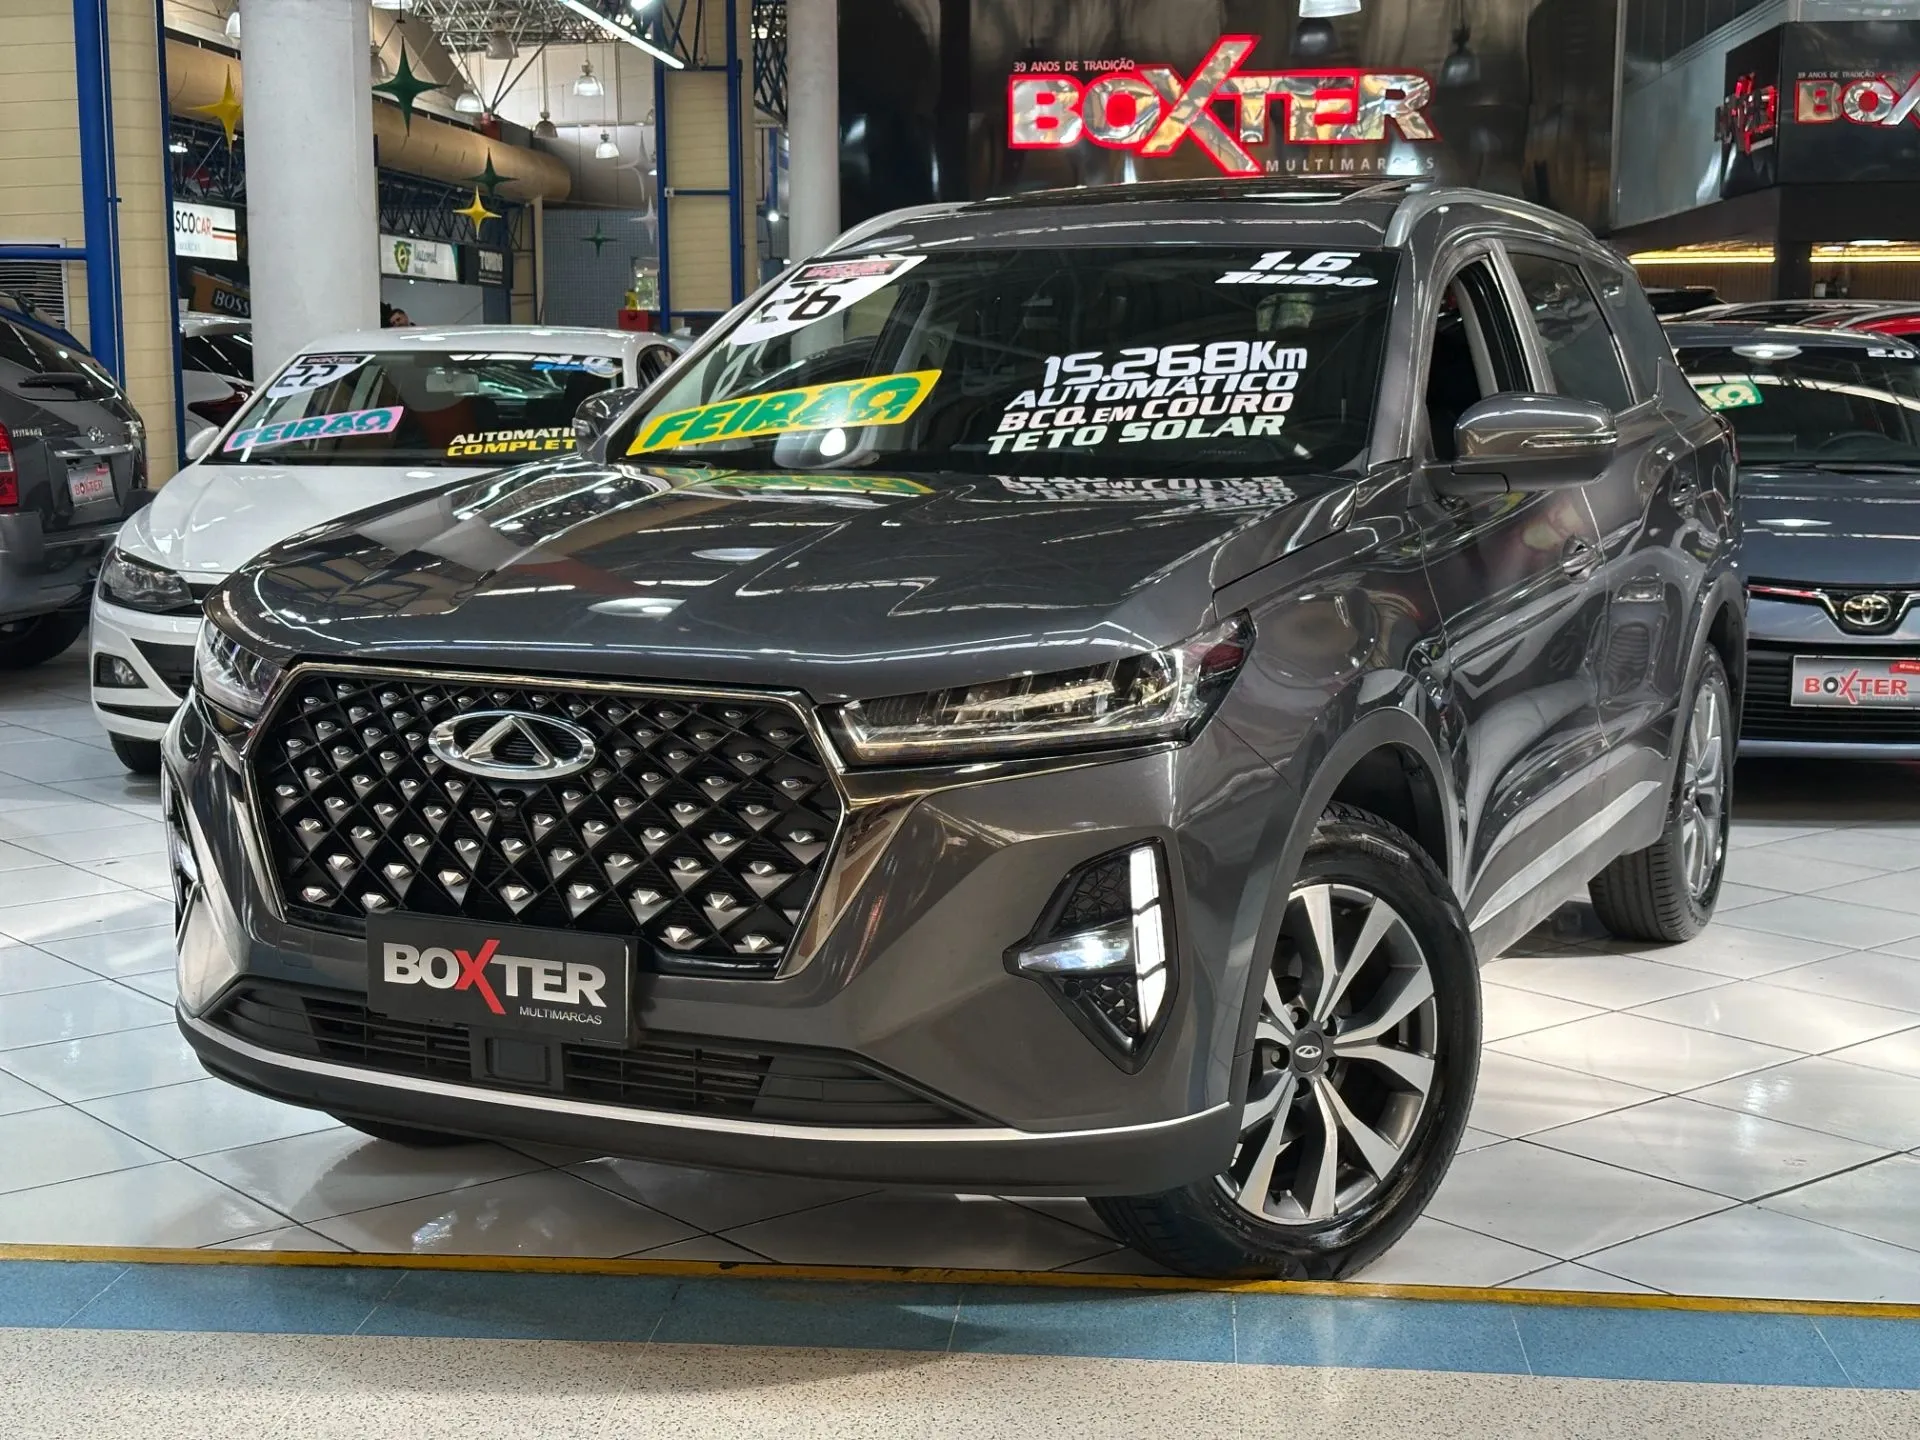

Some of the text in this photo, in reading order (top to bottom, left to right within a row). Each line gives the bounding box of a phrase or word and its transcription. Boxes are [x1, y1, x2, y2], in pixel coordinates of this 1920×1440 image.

[1014, 57, 1135, 72] 39 ANOS DE TRADIÇÃO
[1008, 34, 1442, 177] BOXTER
[1250, 250, 1362, 272] 1.6
[1214, 271, 1379, 287] Turbo
[1042, 340, 1308, 389] 15.268Km
[1866, 347, 1915, 359] 2.0
[274, 364, 339, 388] 22
[641, 376, 922, 449] FEIRÃO
[1091, 404, 1137, 424] EM
[1141, 391, 1294, 419] COURO
[987, 414, 1286, 455] TETO SOLAR
[1803, 668, 1909, 705] BOXTER
[383, 939, 607, 1016] BOXTER
[519, 1005, 603, 1026] MULTIMARCAS
